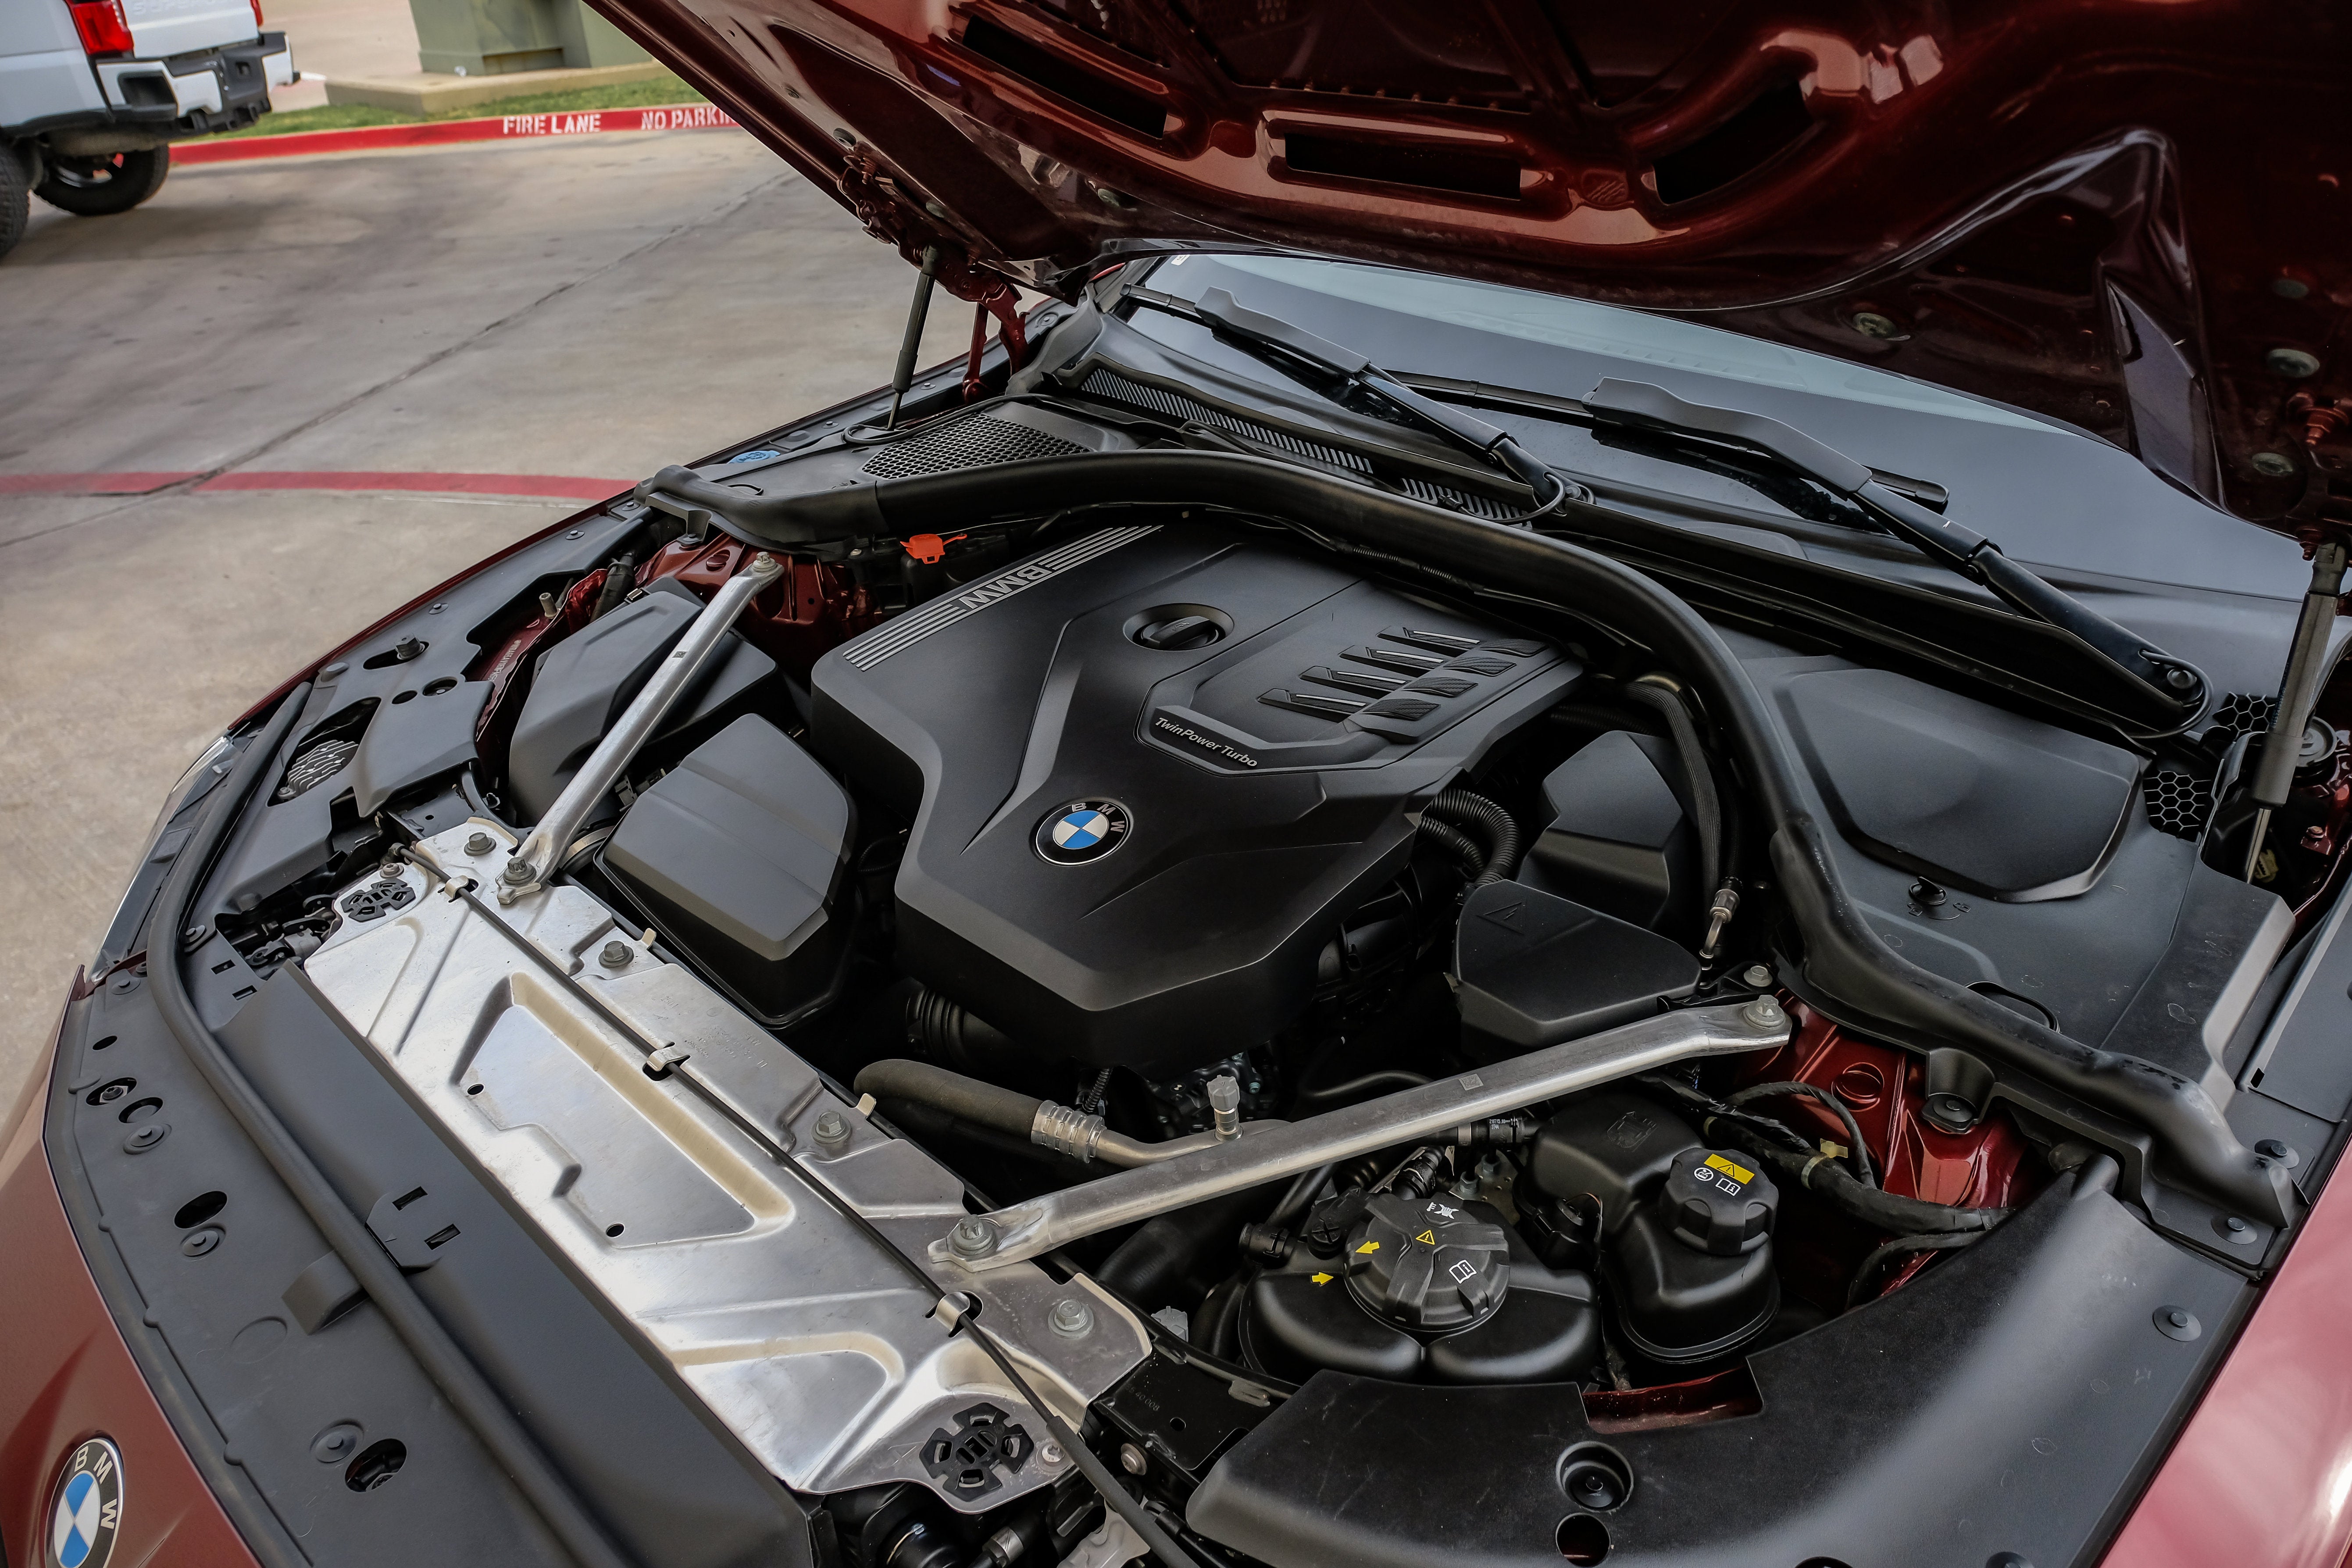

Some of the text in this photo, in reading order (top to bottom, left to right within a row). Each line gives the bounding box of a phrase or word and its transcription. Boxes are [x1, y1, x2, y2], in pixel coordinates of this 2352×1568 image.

[503, 114, 601, 134] FIRE LANE
[641, 111, 667, 130] NO
[958, 565, 1053, 609] BMW
[1155, 717, 1257, 767] TwinPower Turbo
[1072, 802, 1125, 833] BMW
[74, 1446, 118, 1529] BMW
